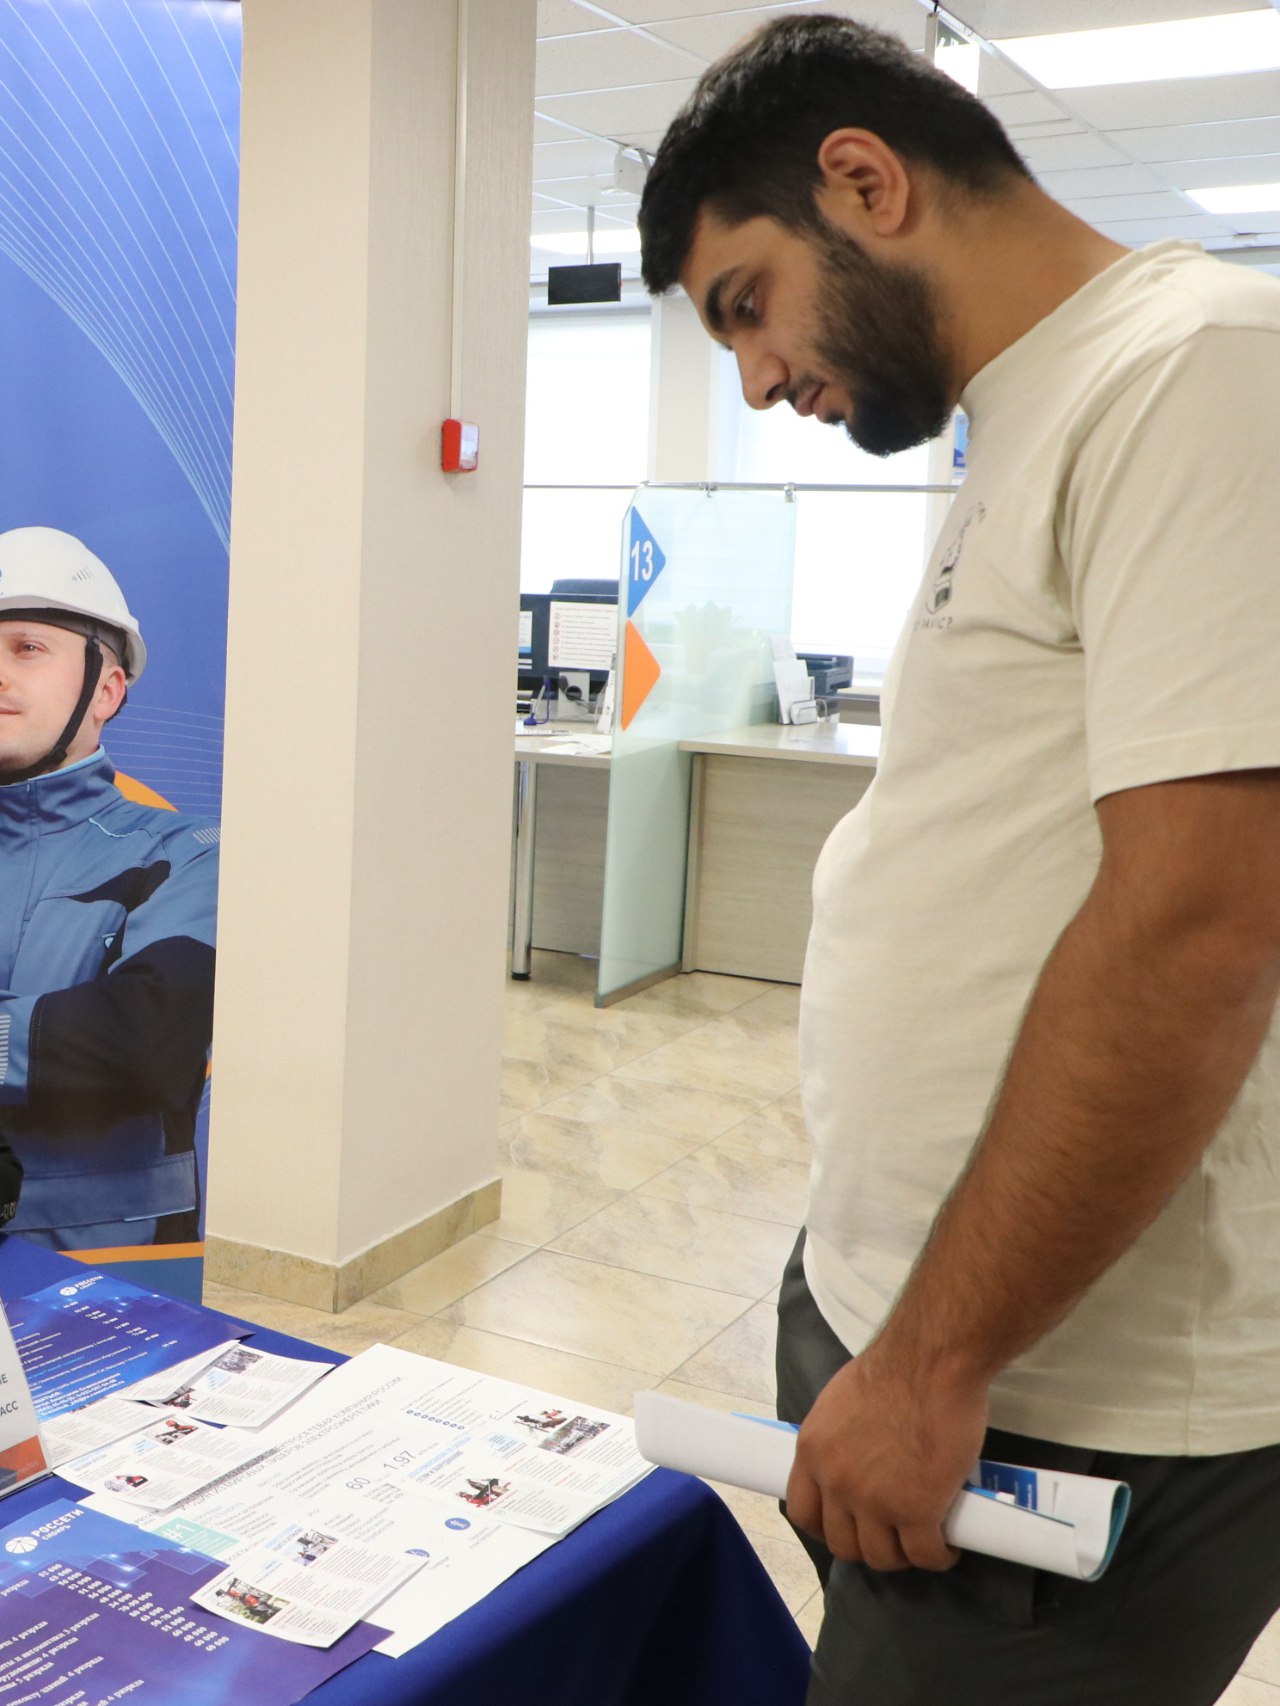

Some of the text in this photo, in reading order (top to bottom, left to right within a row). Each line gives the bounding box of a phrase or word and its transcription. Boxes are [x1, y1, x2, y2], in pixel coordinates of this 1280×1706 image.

[631, 540, 654, 581] 13
[345, 1477, 371, 1490] 60
[31, 1509, 85, 1537] РОССЕТИ
